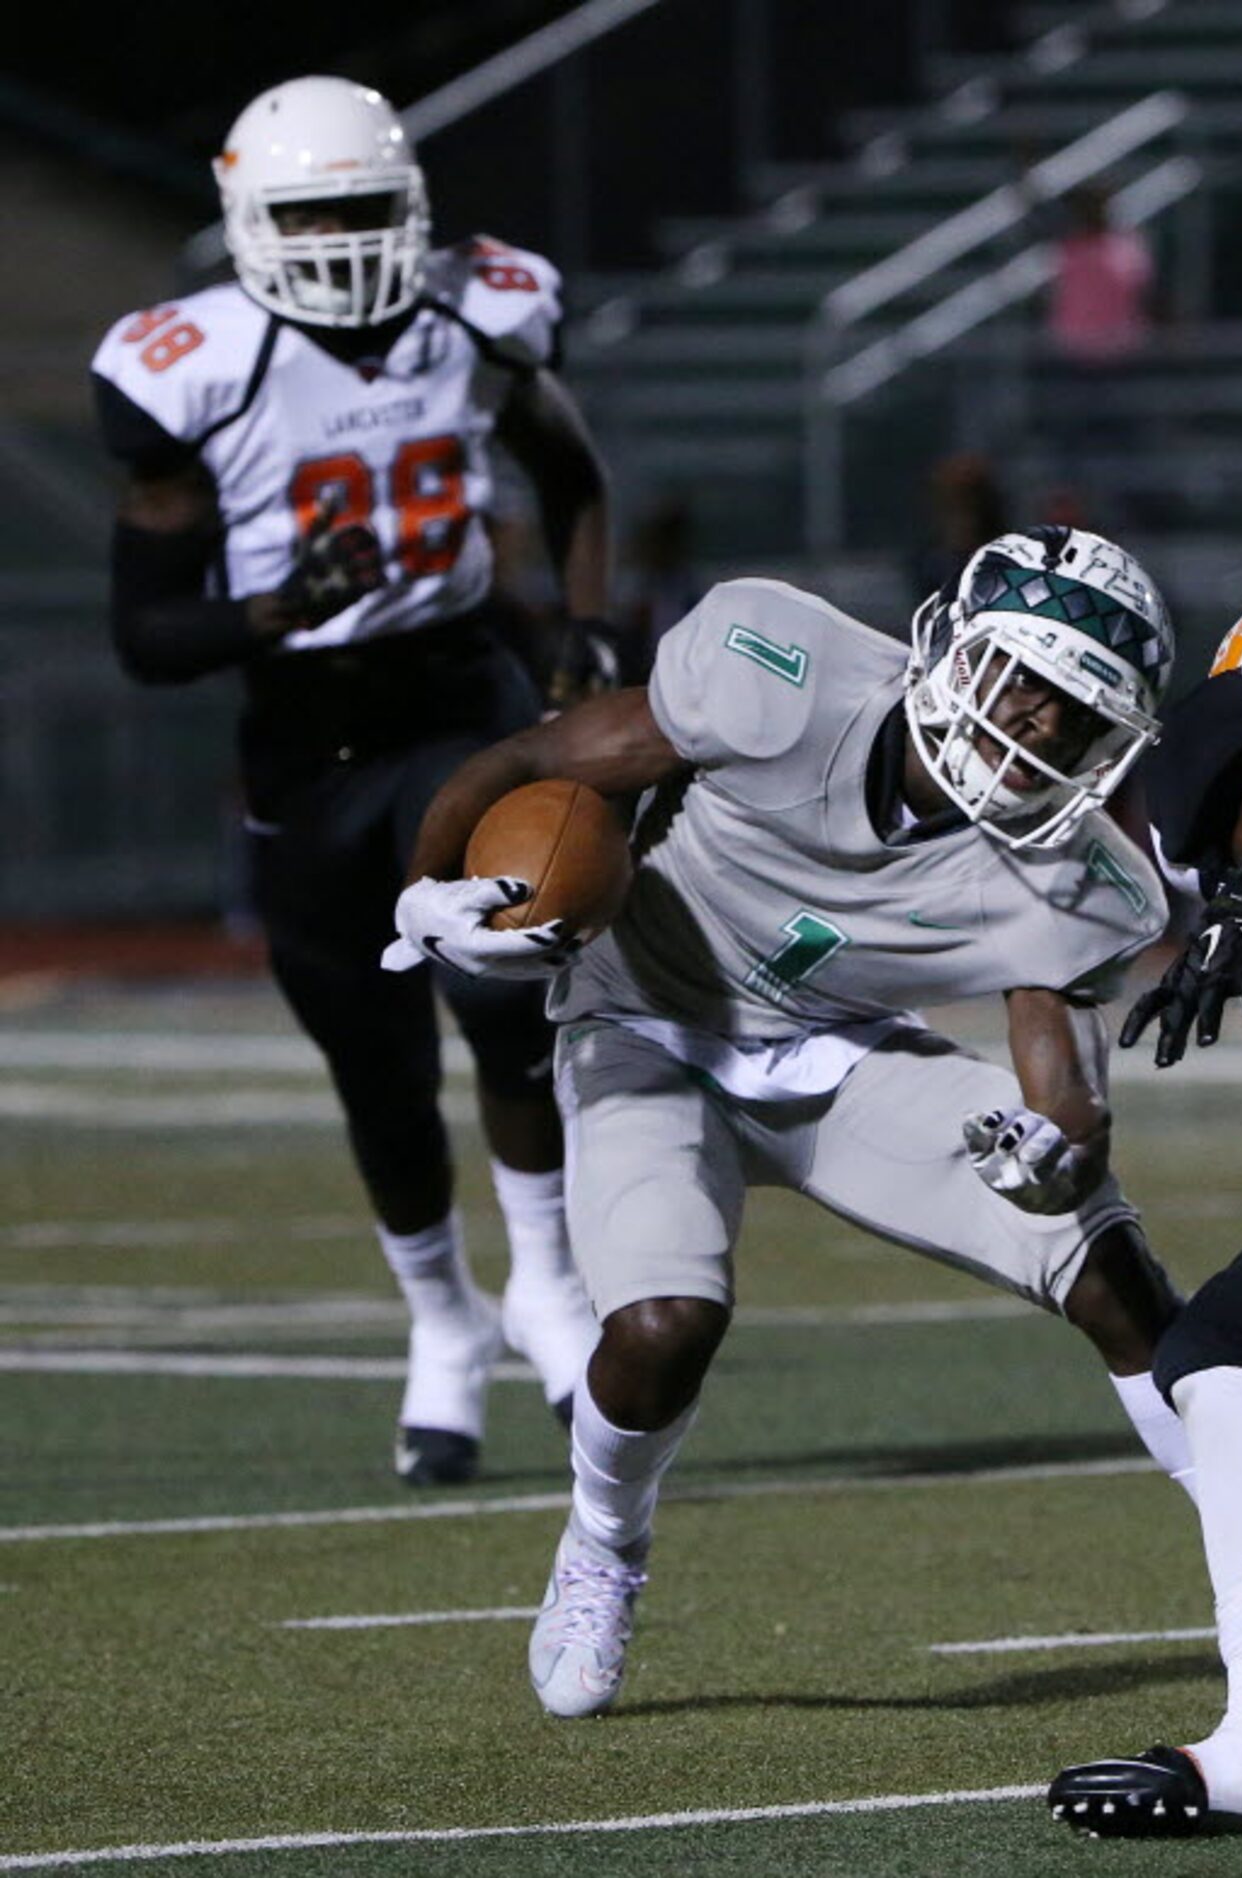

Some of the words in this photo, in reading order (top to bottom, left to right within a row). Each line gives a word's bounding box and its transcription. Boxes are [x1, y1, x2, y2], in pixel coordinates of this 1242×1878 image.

[724, 622, 811, 690] 1
[1086, 837, 1148, 918] 1
[742, 906, 852, 1003] 1
